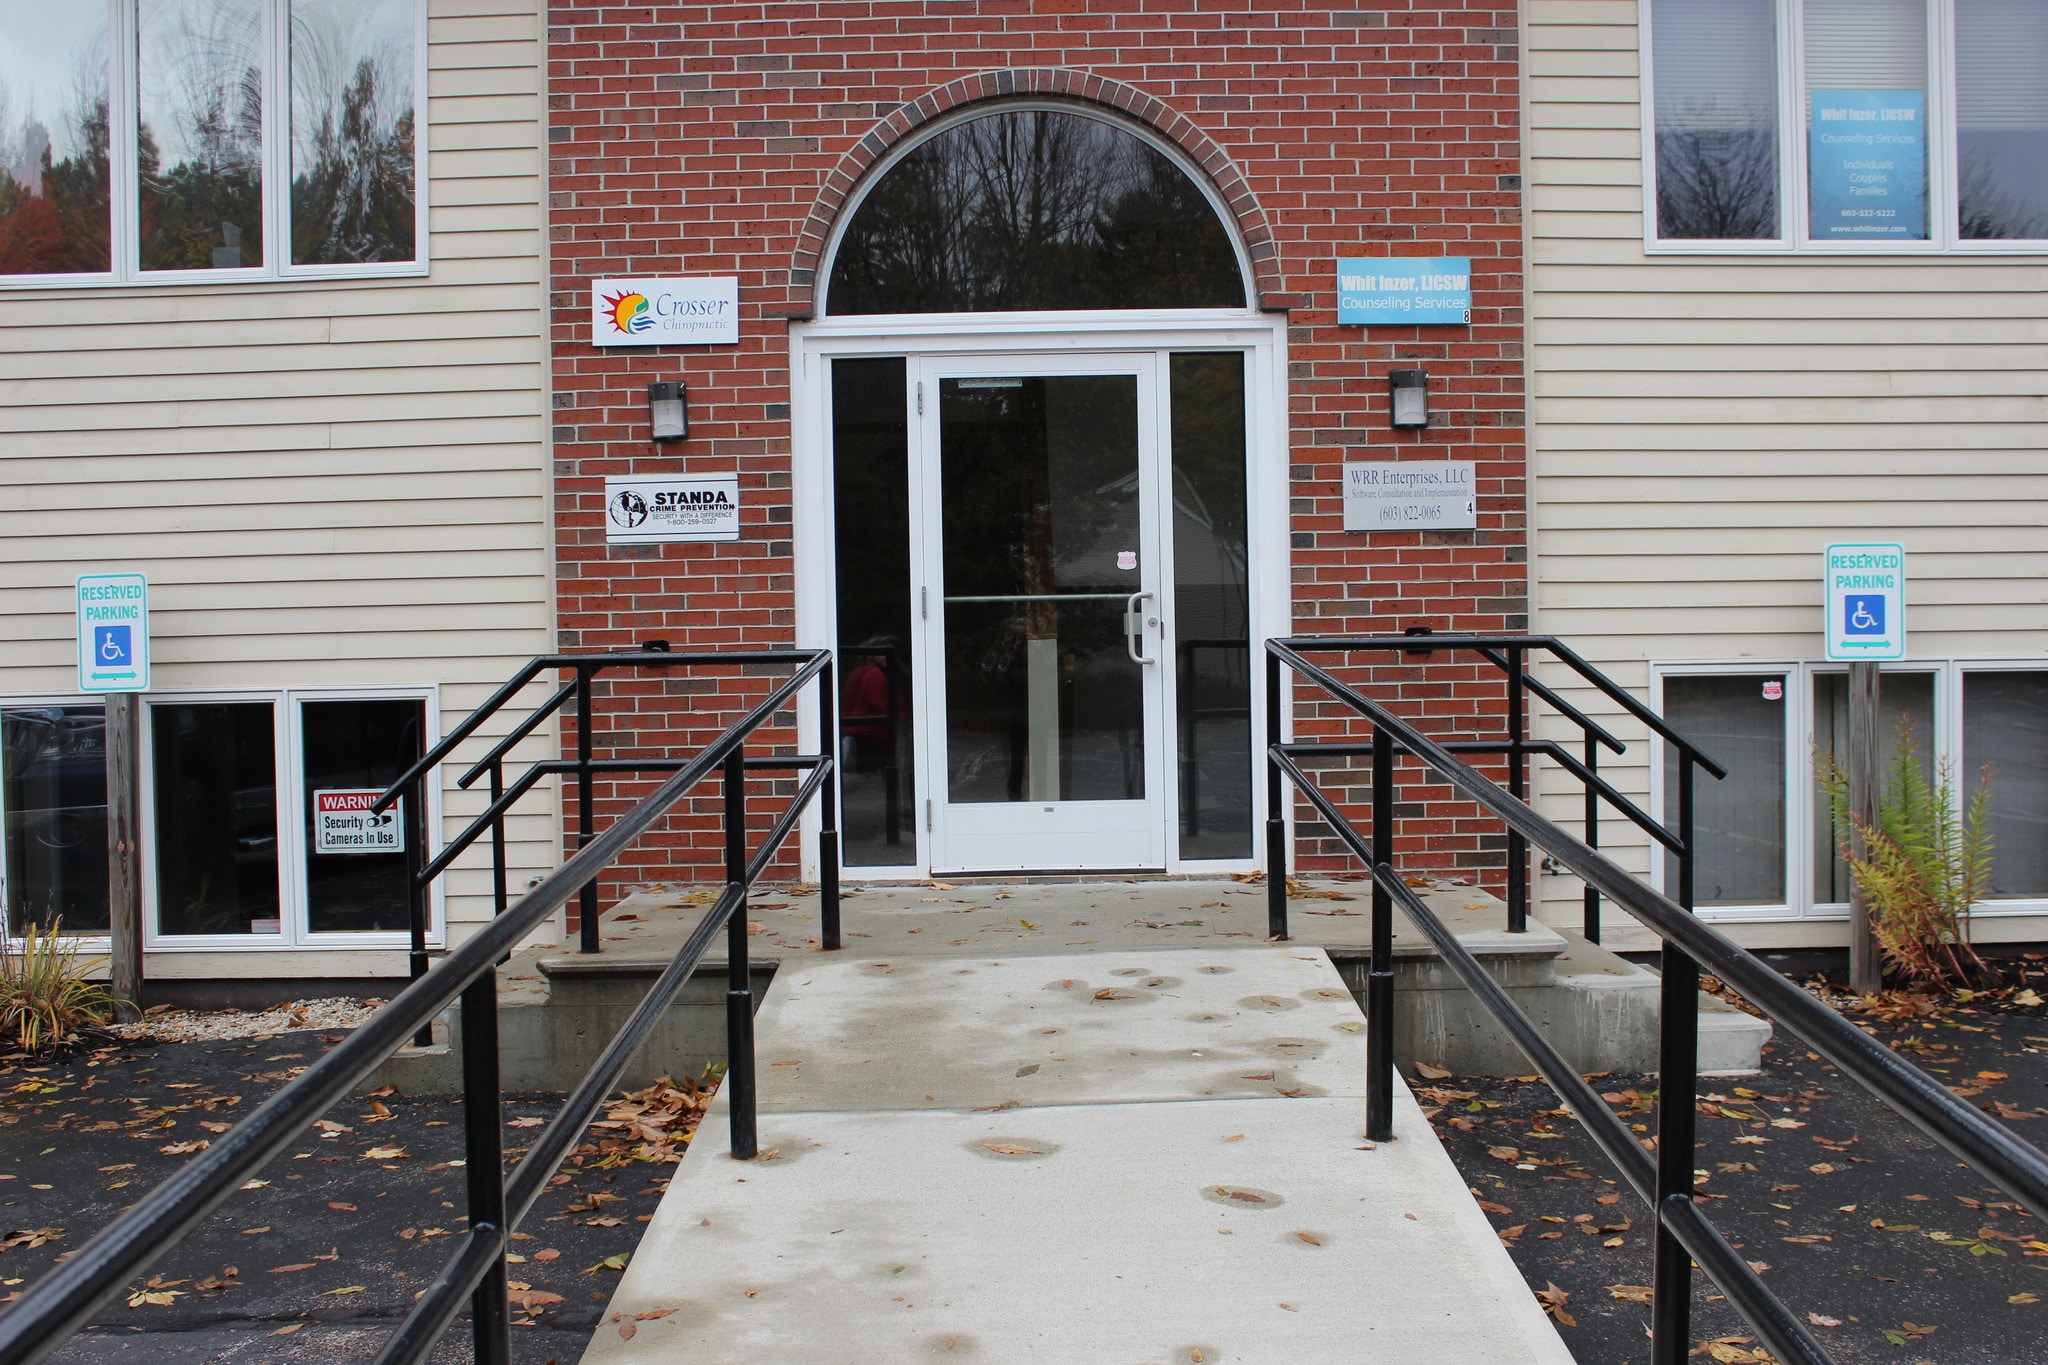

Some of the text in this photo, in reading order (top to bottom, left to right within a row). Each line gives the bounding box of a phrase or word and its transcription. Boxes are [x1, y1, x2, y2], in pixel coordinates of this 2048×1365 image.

[1820, 108, 1848, 120] Whit
[1881, 108, 1915, 121] LICSW
[1821, 133, 1915, 145] Counseling Services
[1843, 160, 1894, 169] Individuals
[1850, 173, 1887, 183] Couples
[1850, 186, 1888, 195] Families
[1341, 274, 1467, 292] Whit Inzer, LICSW
[656, 293, 729, 316] Crosser
[1342, 296, 1467, 311] Counseling Services
[1463, 311, 1470, 322] 8
[663, 319, 729, 332] Chiropractic
[1351, 468, 1469, 488] WRR Enterprises, LLC
[655, 490, 728, 505] STANDA
[1352, 487, 1468, 499] Software Consultation and Implementation
[649, 503, 736, 513] CRIME PREVENTION
[1379, 505, 1441, 524] (603) 822-0065
[1467, 502, 1473, 514] 4
[700, 511, 733, 519] DIFFERENCE
[1831, 554, 1899, 569] RESERVED
[1836, 575, 1895, 588] PARKING
[81, 585, 142, 601] RESERVED
[86, 605, 139, 620] PARKING
[323, 795, 393, 809] WARNI
[324, 816, 364, 830] Security
[325, 832, 364, 845] Cameras
[367, 831, 375, 844] In
[378, 831, 394, 844] Use
